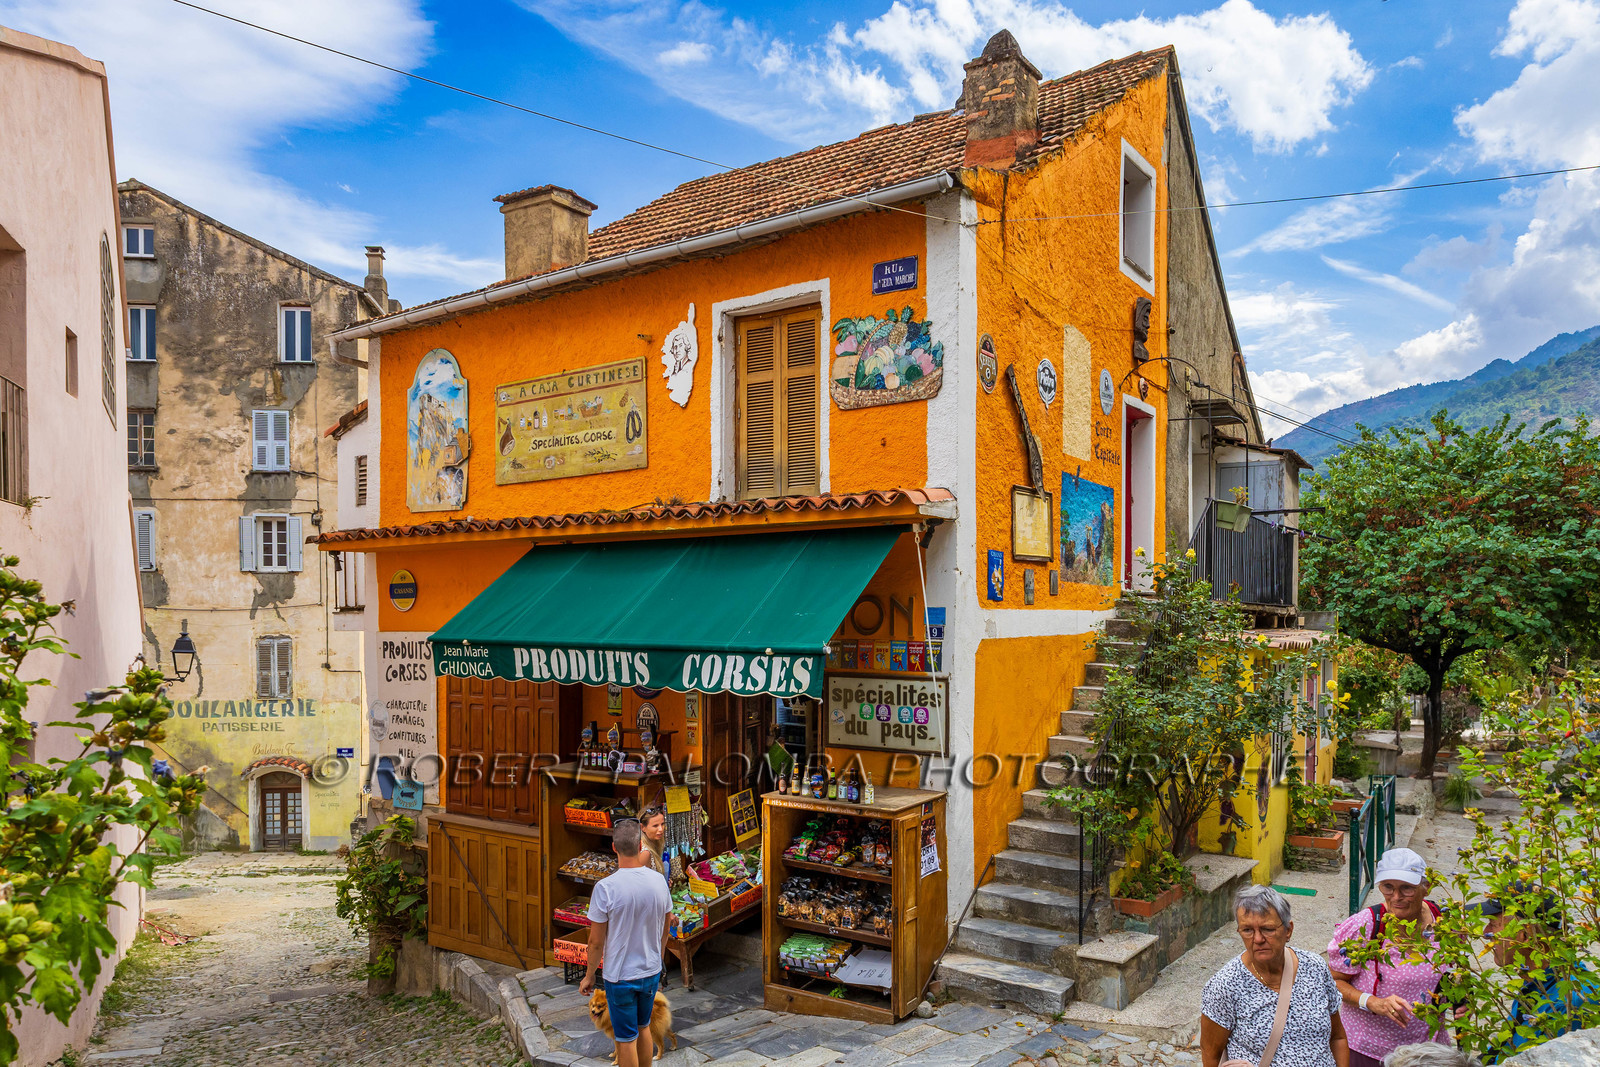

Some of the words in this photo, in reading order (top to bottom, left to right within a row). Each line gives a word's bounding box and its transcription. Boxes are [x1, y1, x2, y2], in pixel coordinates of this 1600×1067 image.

[519, 386, 527, 398] A
[567, 365, 639, 389] CURTINESE
[394, 587, 414, 595] CASANIS
[932, 627, 938, 637] 9
[443, 646, 462, 657] Jean
[464, 646, 489, 658] Marie
[385, 663, 428, 683] CORSES
[438, 660, 495, 677] GHIONGA
[513, 647, 650, 686] PRODUITS
[681, 653, 814, 694] CORSES
[831, 684, 942, 710] spécialités
[386, 699, 428, 713] CHARCUTERIE
[202, 722, 285, 732] PATISSERIE
[391, 714, 425, 728] FROMAGES
[844, 714, 868, 736] du
[388, 730, 427, 745] CONFITURES
[398, 748, 416, 759] MIEL
